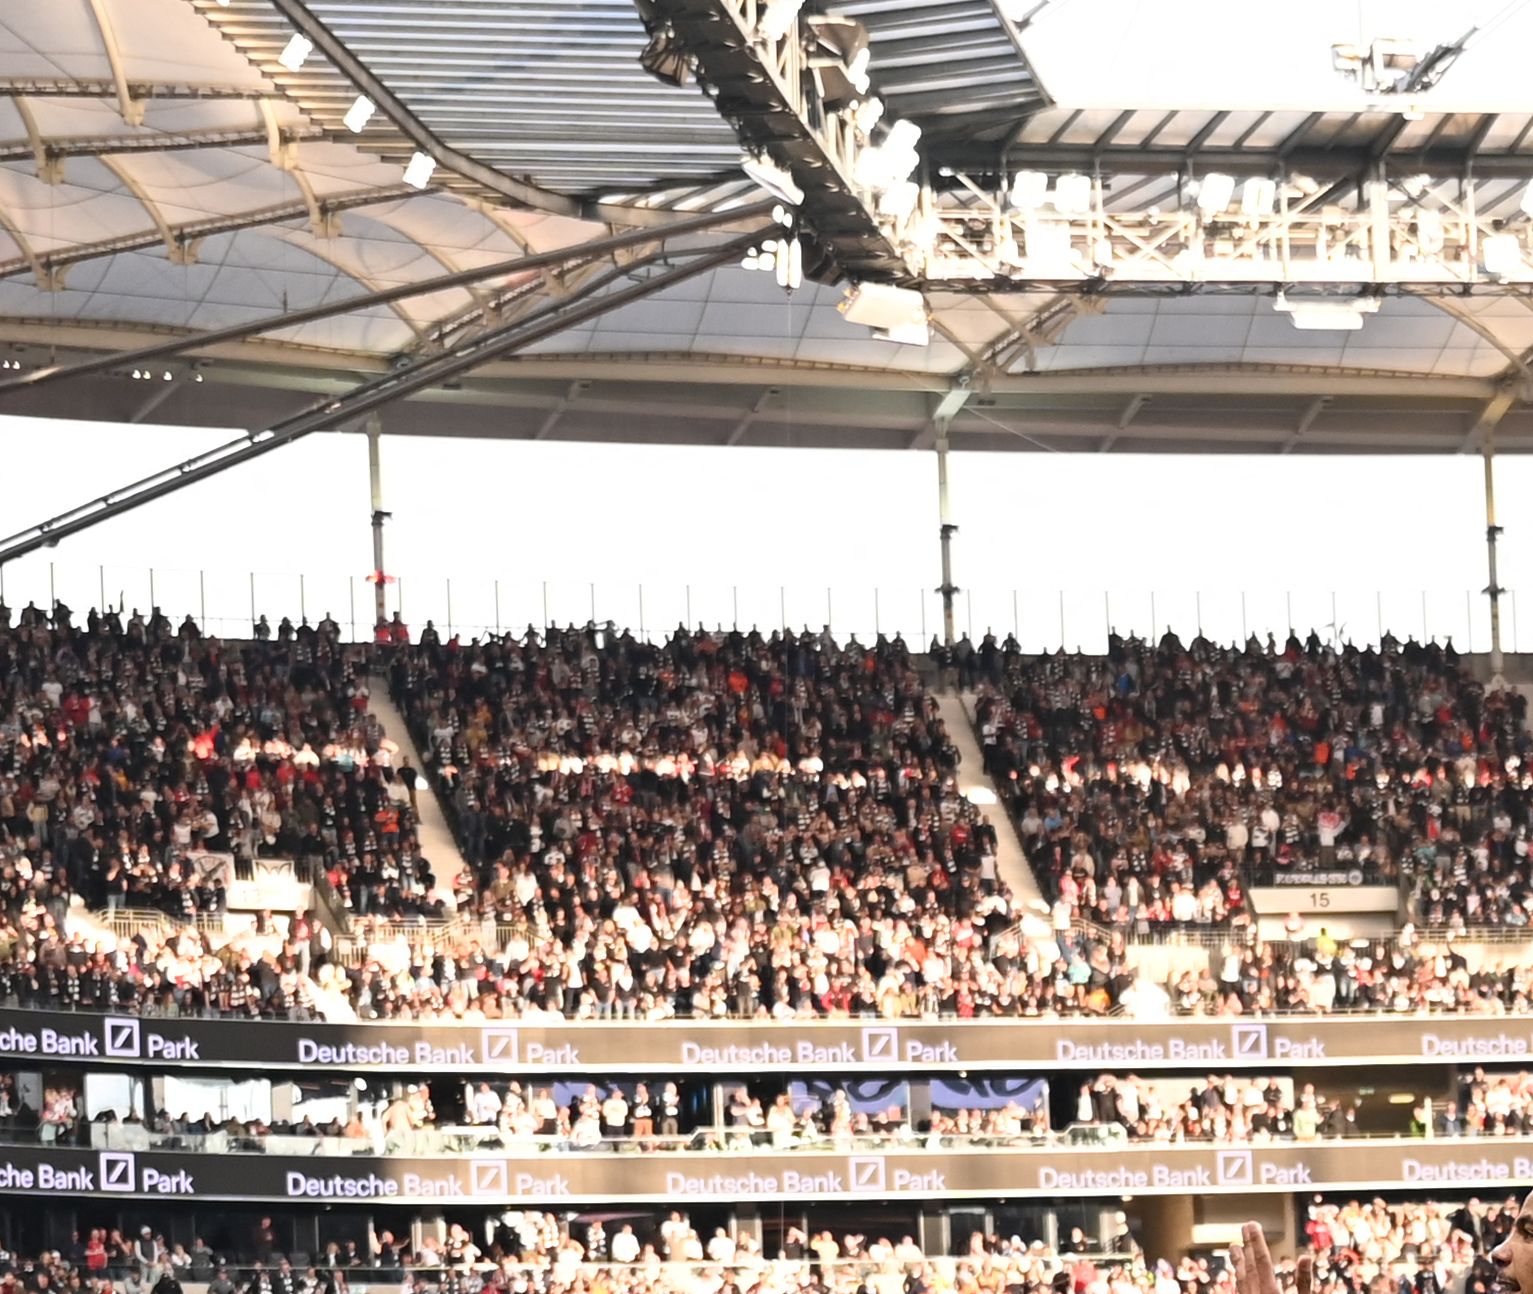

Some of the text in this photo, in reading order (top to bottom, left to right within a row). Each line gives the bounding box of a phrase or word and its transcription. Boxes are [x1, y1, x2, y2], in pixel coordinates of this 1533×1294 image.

[1310, 892, 1330, 908] 15
[42, 1029, 98, 1056] Bank
[148, 1034, 199, 1060] Park
[298, 1039, 580, 1064] Deutsche Bank Park
[680, 1038, 957, 1063] Deutsche Bank Park
[1056, 1036, 1325, 1060] Deutsche Bank Park
[1420, 1031, 1526, 1055] Deutsche
[38, 1165, 94, 1190] Bank
[143, 1169, 195, 1193] Park
[1039, 1162, 1311, 1189] Deutsche Bank Park
[1401, 1156, 1509, 1180] Deutsche
[286, 1172, 570, 1197] Deutsche Bank Park
[666, 1169, 946, 1195] Deutsche Bank Park
